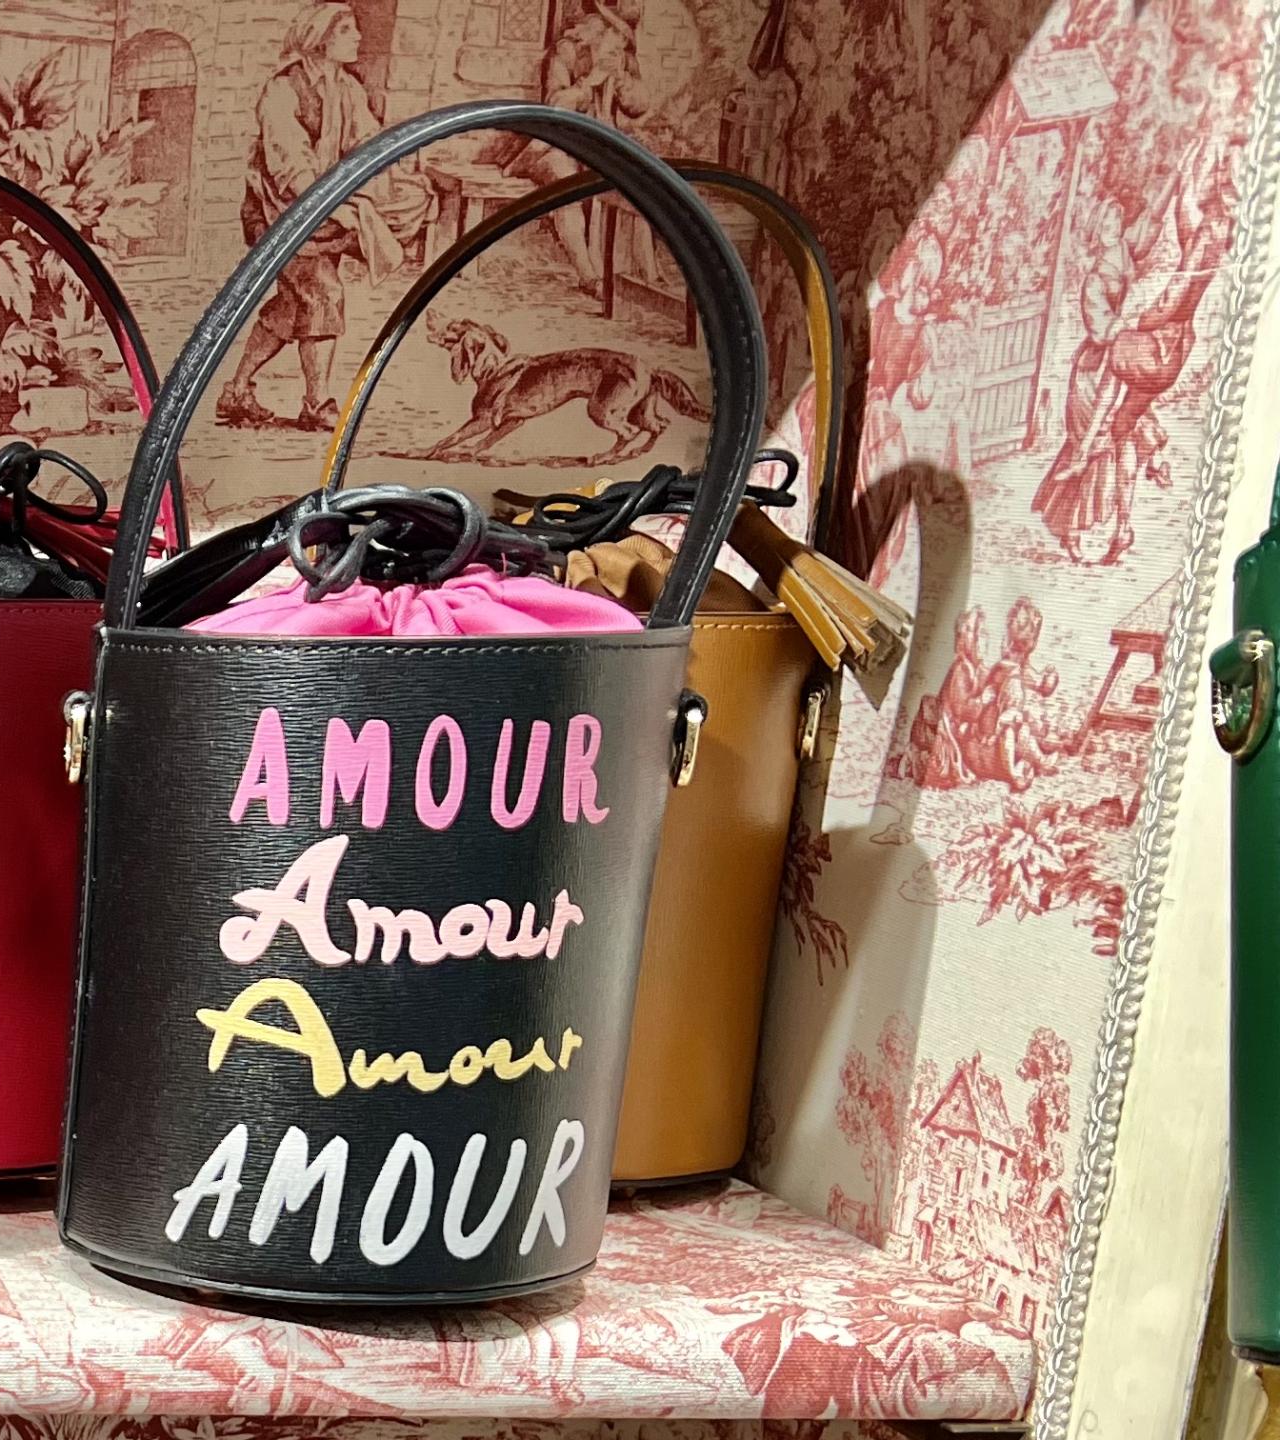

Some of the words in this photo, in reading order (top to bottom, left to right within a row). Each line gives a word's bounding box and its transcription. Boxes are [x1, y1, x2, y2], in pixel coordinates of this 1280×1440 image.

[228, 706, 610, 830] AMOUR
[218, 834, 584, 966] Amour
[195, 977, 583, 1098] Amour
[164, 1118, 585, 1266] AMOUR
